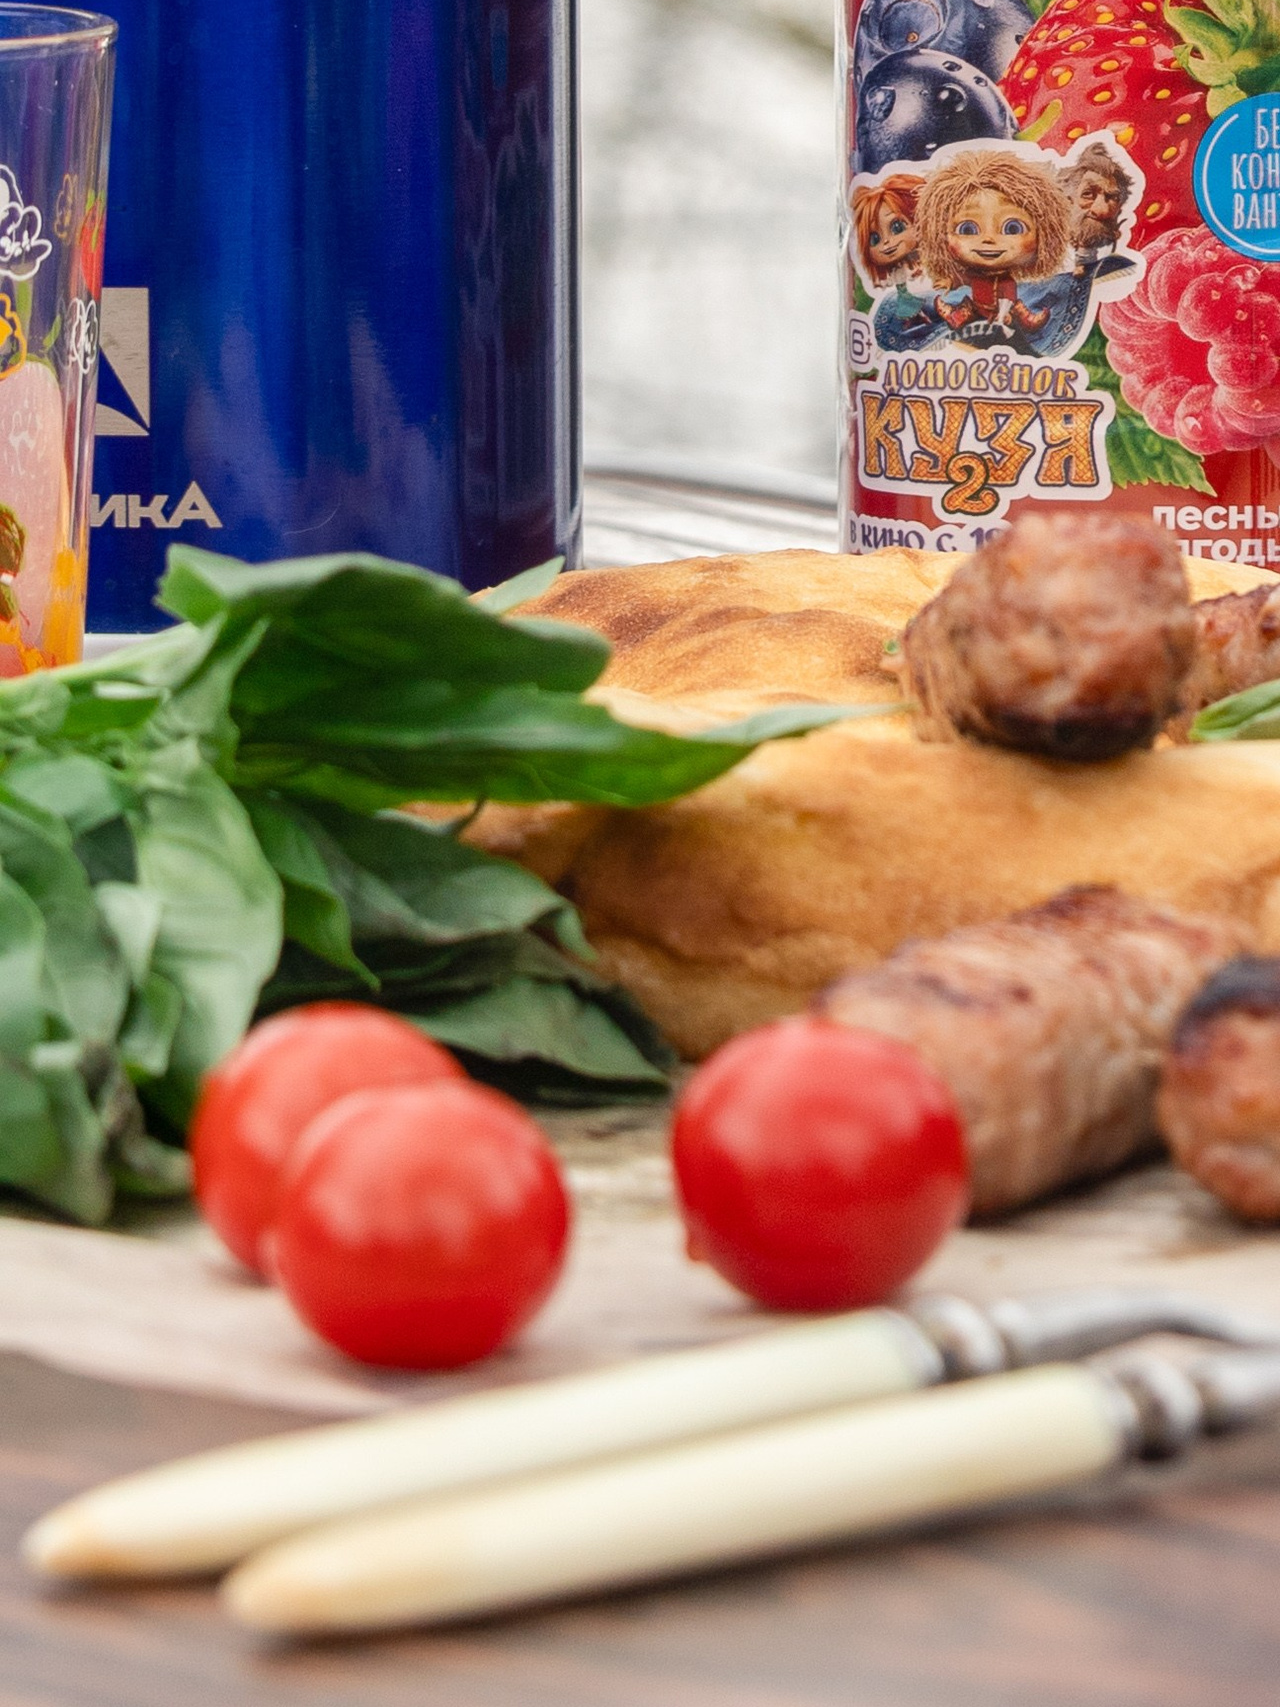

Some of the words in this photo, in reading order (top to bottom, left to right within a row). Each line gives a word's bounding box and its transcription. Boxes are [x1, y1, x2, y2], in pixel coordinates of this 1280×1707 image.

[852, 328, 873, 357] 6+
[860, 390, 1104, 488] КУЗЯ
[941, 451, 1000, 516] 2
